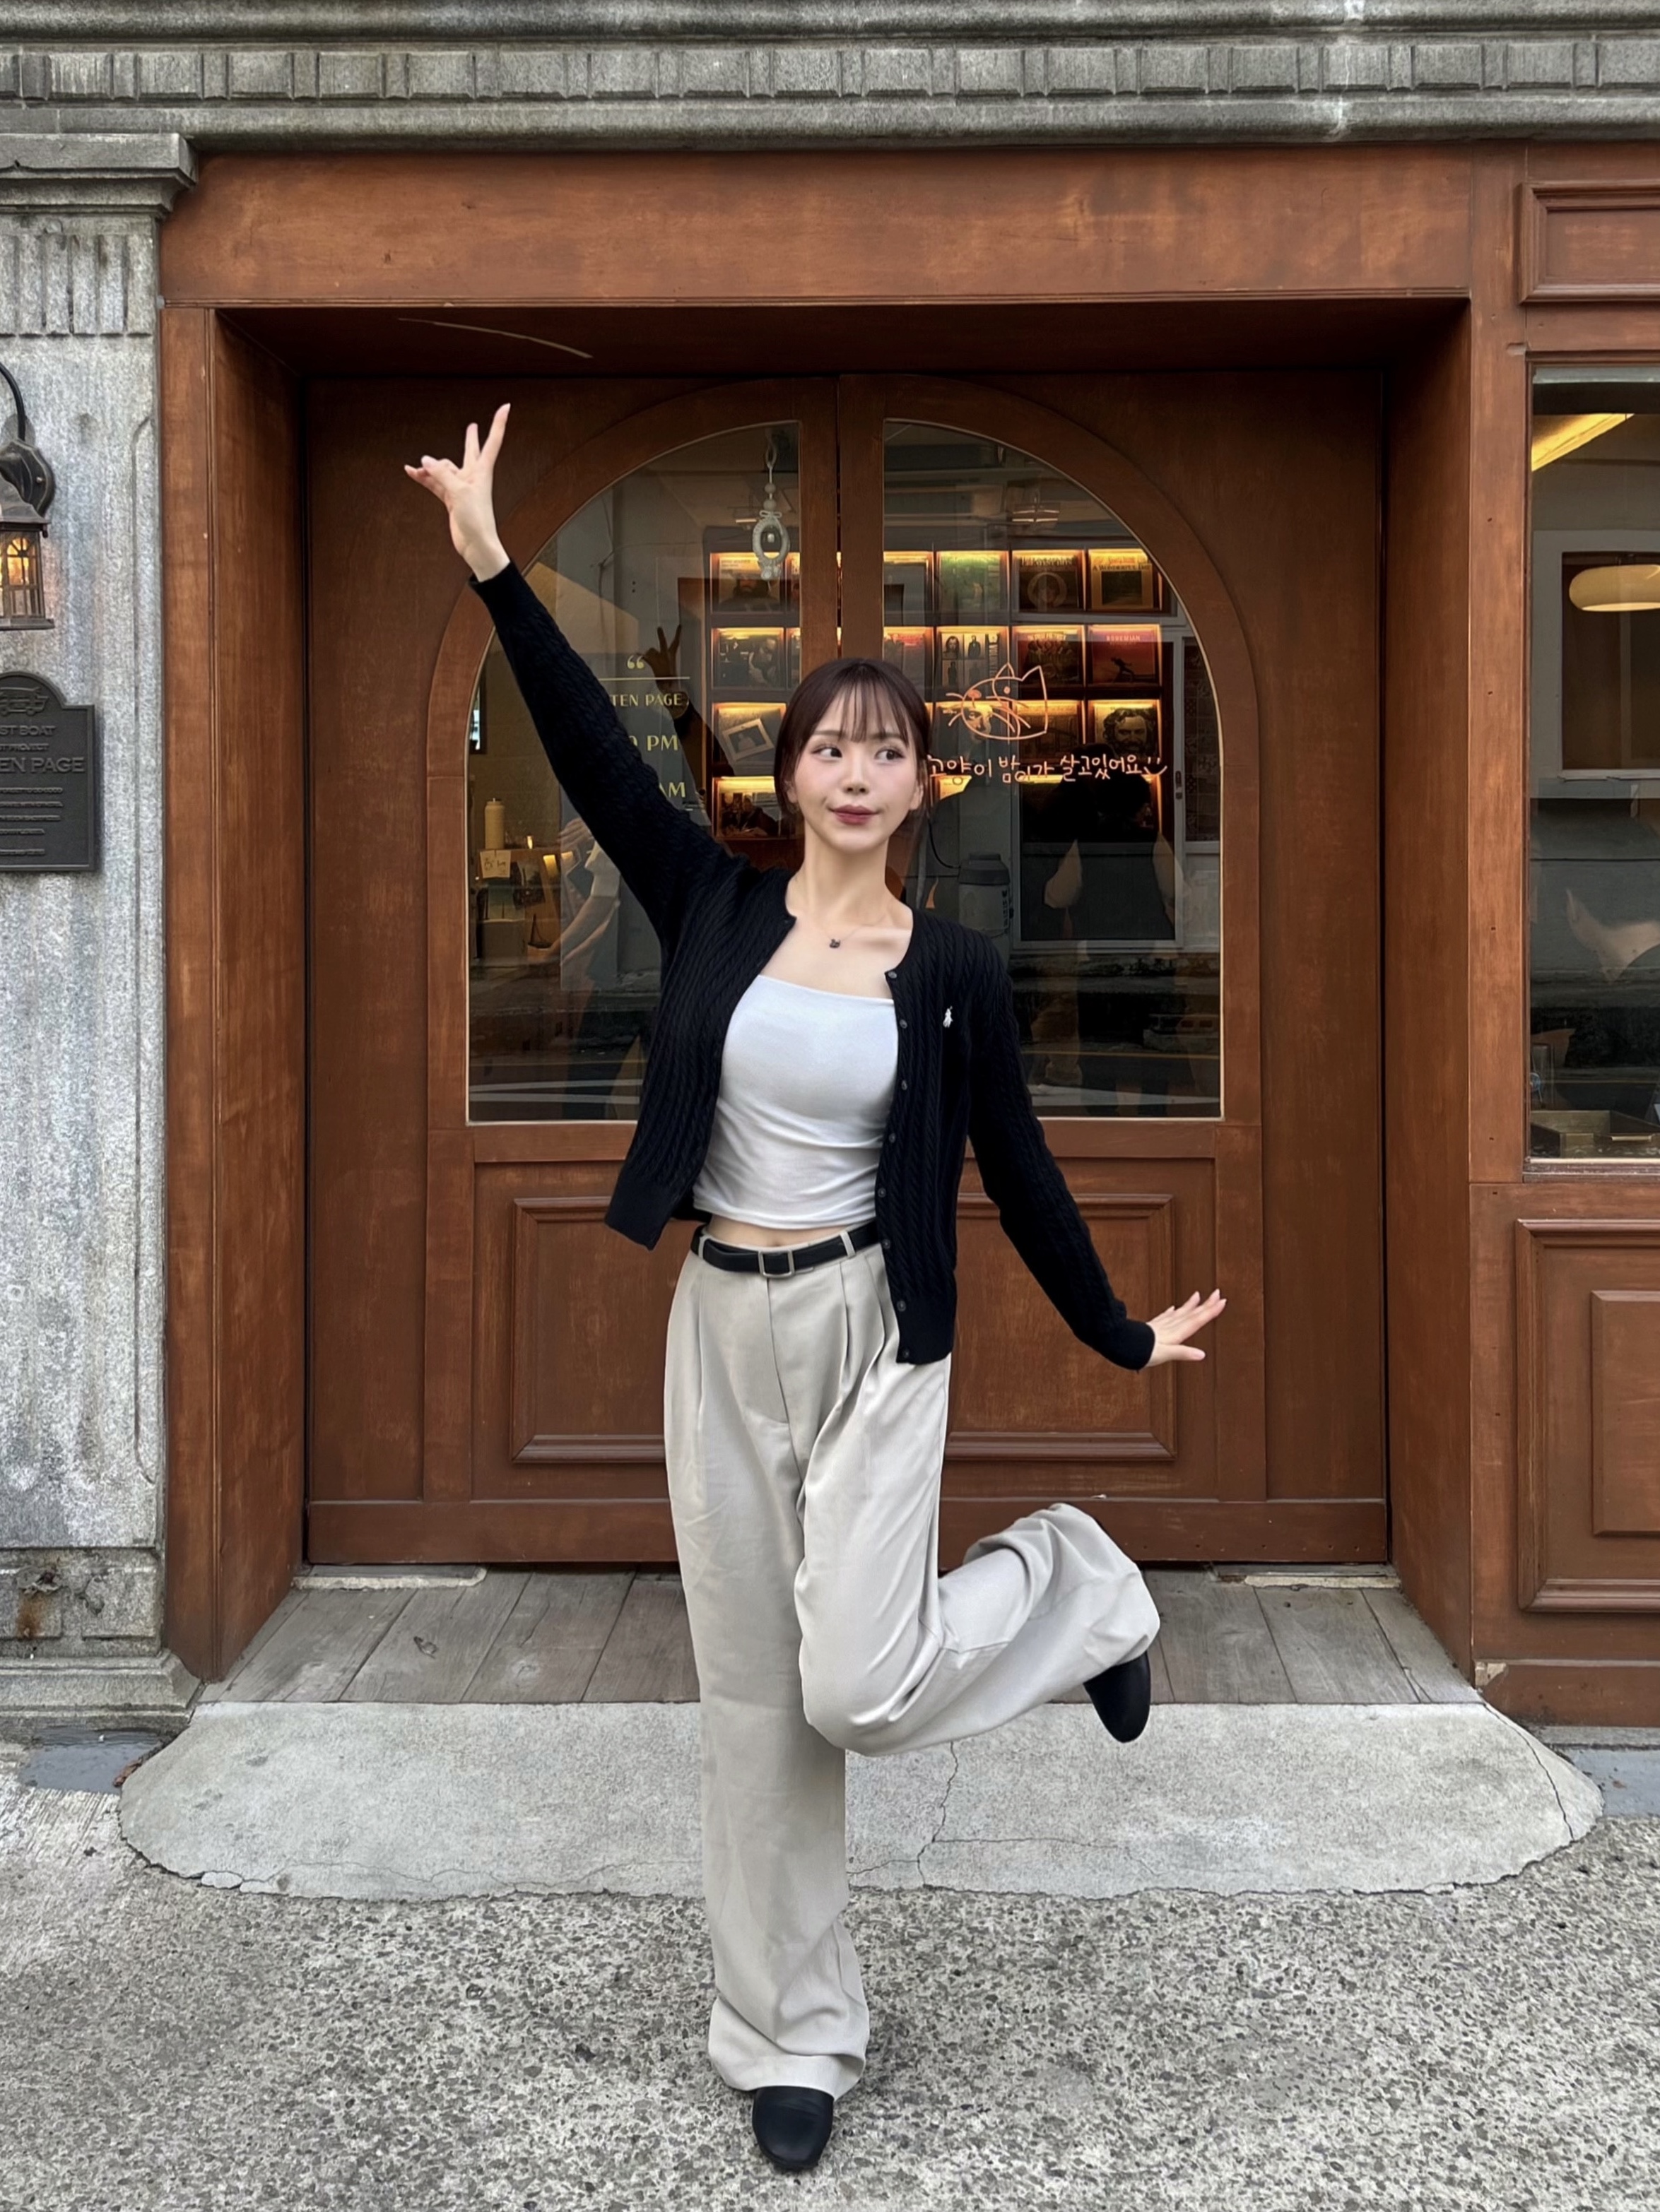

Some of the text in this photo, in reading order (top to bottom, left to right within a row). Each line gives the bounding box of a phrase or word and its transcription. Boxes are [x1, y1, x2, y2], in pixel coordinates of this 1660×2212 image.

[611, 694, 683, 706] TEN PAGE
[19, 725, 57, 736] BOAT
[647, 735, 678, 751] PM
[30, 757, 85, 774] PAGE
[926, 754, 991, 778] 고양이
